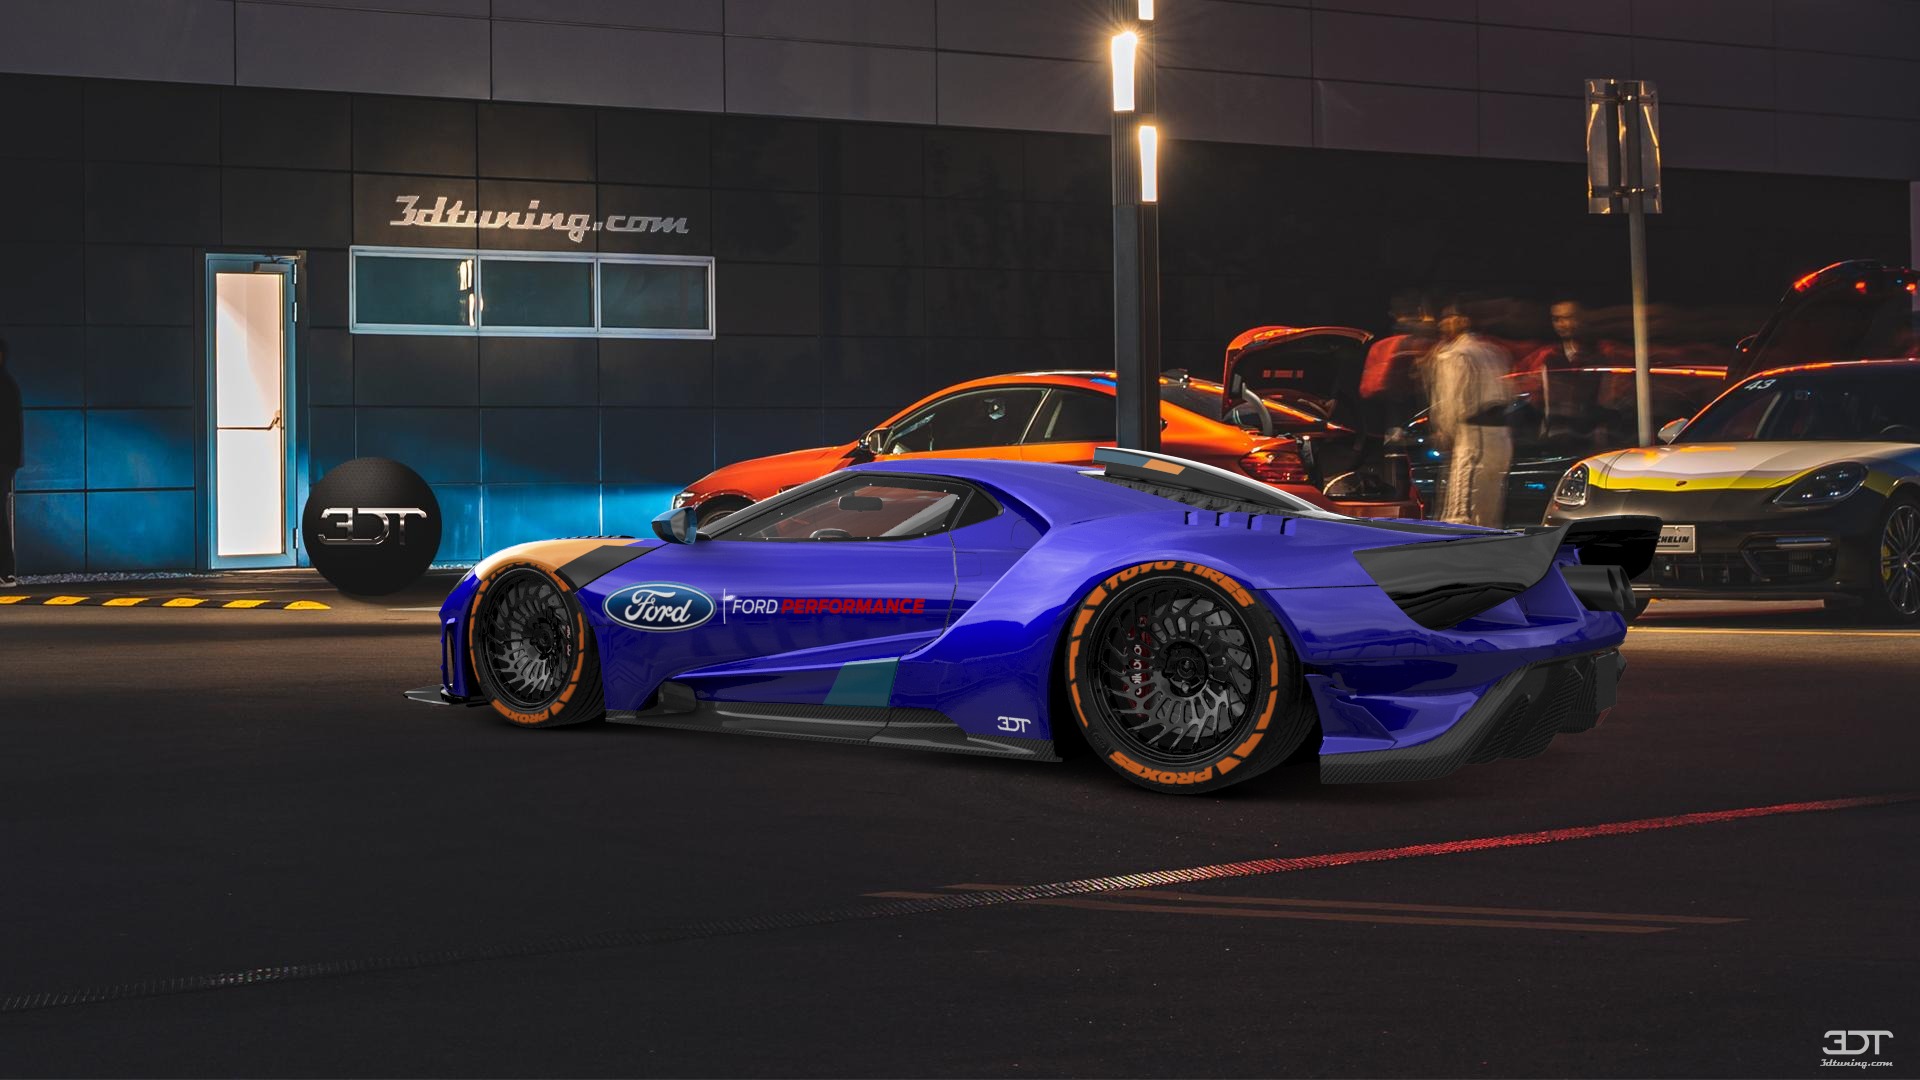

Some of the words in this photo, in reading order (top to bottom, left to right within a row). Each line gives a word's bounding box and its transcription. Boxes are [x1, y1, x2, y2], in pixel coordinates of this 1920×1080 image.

[390, 195, 690, 243] 3dtuning.com
[317, 507, 428, 546] 3DT
[1182, 561, 1255, 608] TIRES
[624, 589, 693, 623] Ford
[732, 599, 779, 615] FORD
[781, 597, 926, 615] PERFORMANCE
[997, 715, 1031, 733] 3DT
[1109, 751, 1213, 785] PROXES
